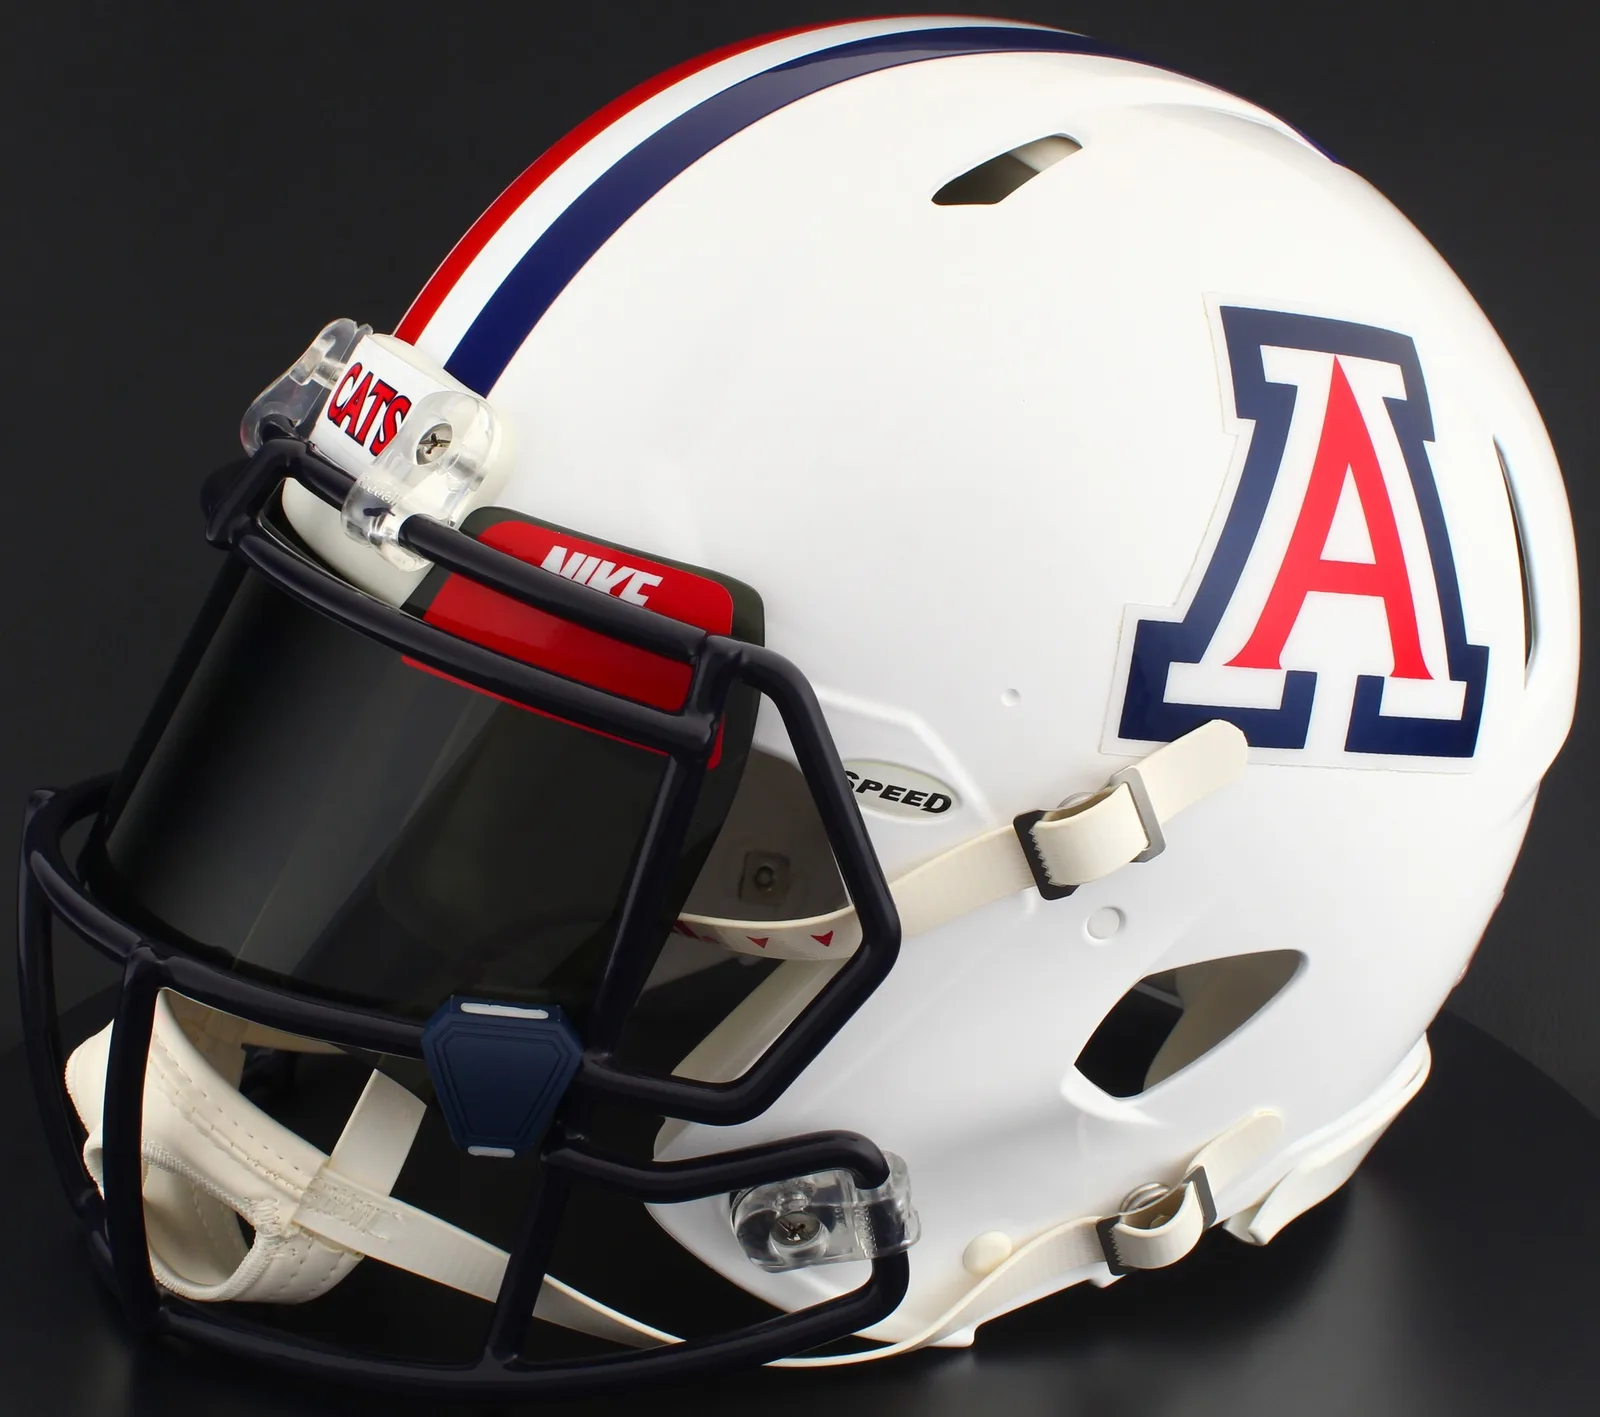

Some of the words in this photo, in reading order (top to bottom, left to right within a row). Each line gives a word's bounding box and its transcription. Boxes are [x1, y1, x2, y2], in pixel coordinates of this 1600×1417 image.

[327, 361, 413, 457] CATS
[540, 545, 664, 607] NIKE
[1117, 305, 1490, 758] A
